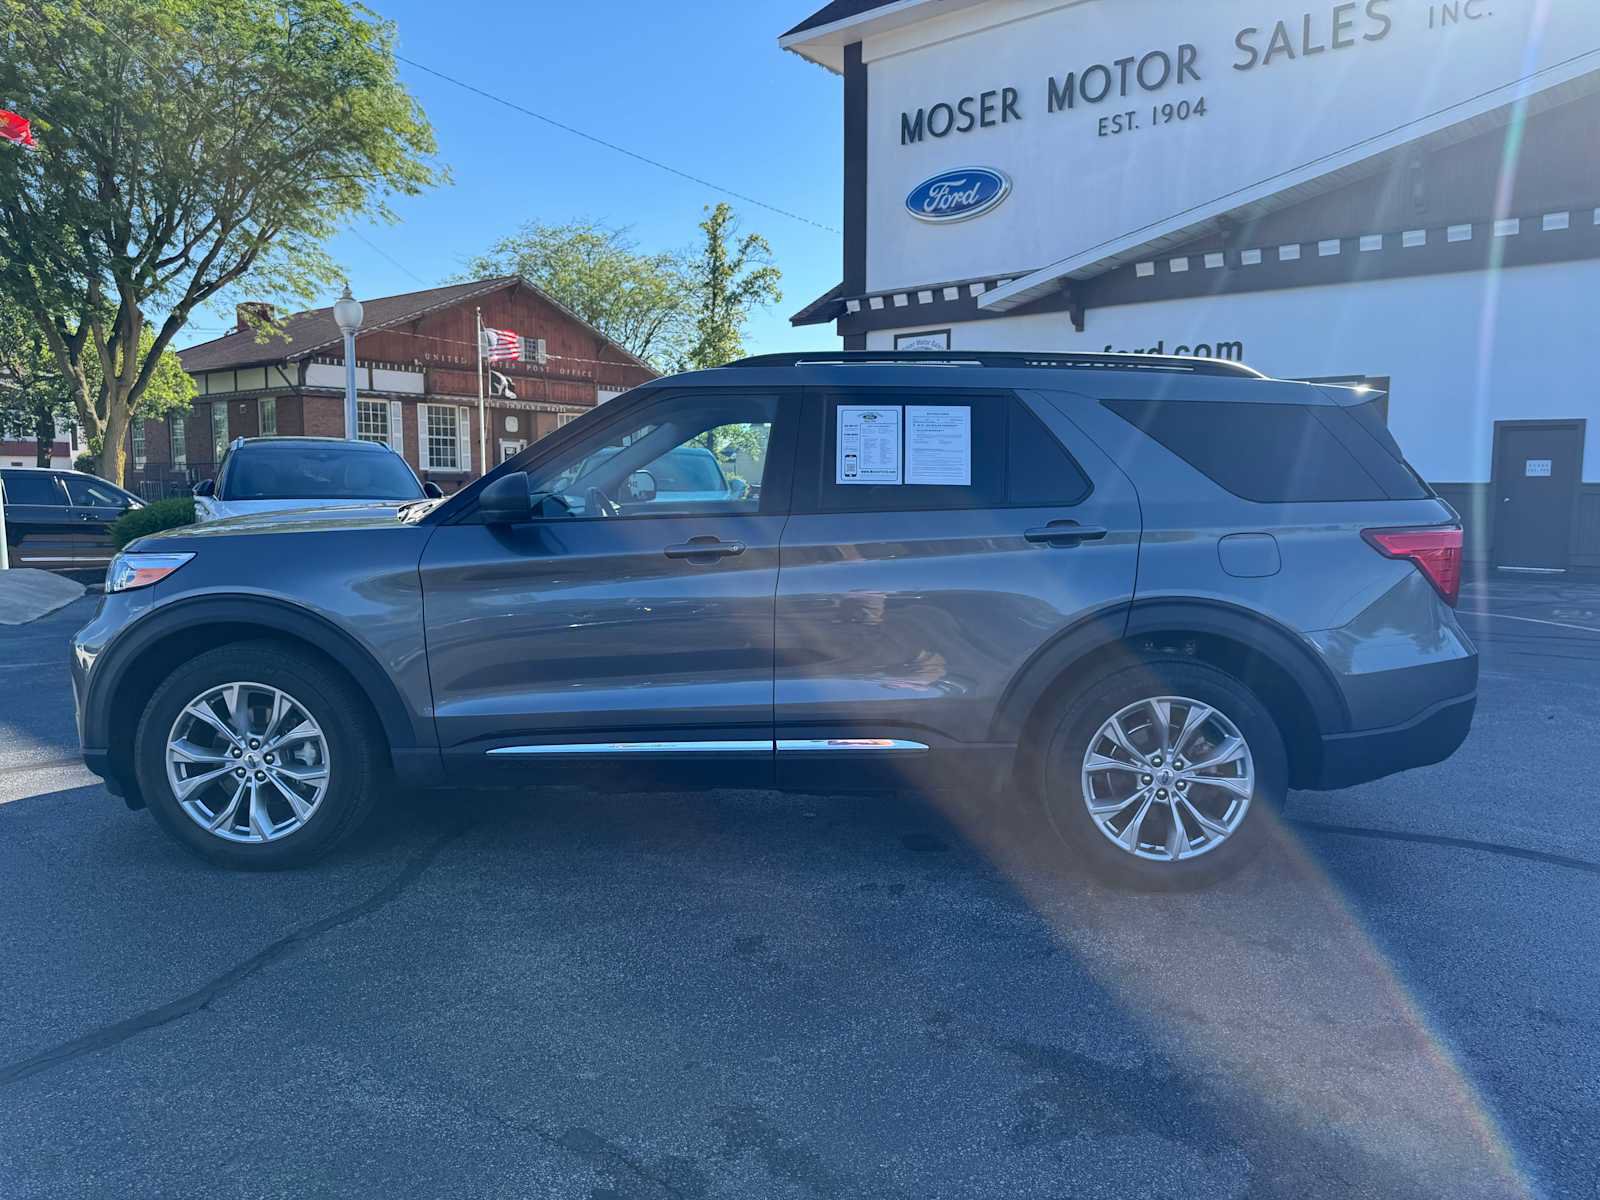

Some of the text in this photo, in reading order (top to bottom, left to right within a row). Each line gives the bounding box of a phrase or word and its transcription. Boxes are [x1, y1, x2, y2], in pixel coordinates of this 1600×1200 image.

[901, 0, 1493, 145] MOSER MOTOR SALES INC.
[1098, 96, 1207, 137] EST. 1904
[924, 178, 981, 212] Ford
